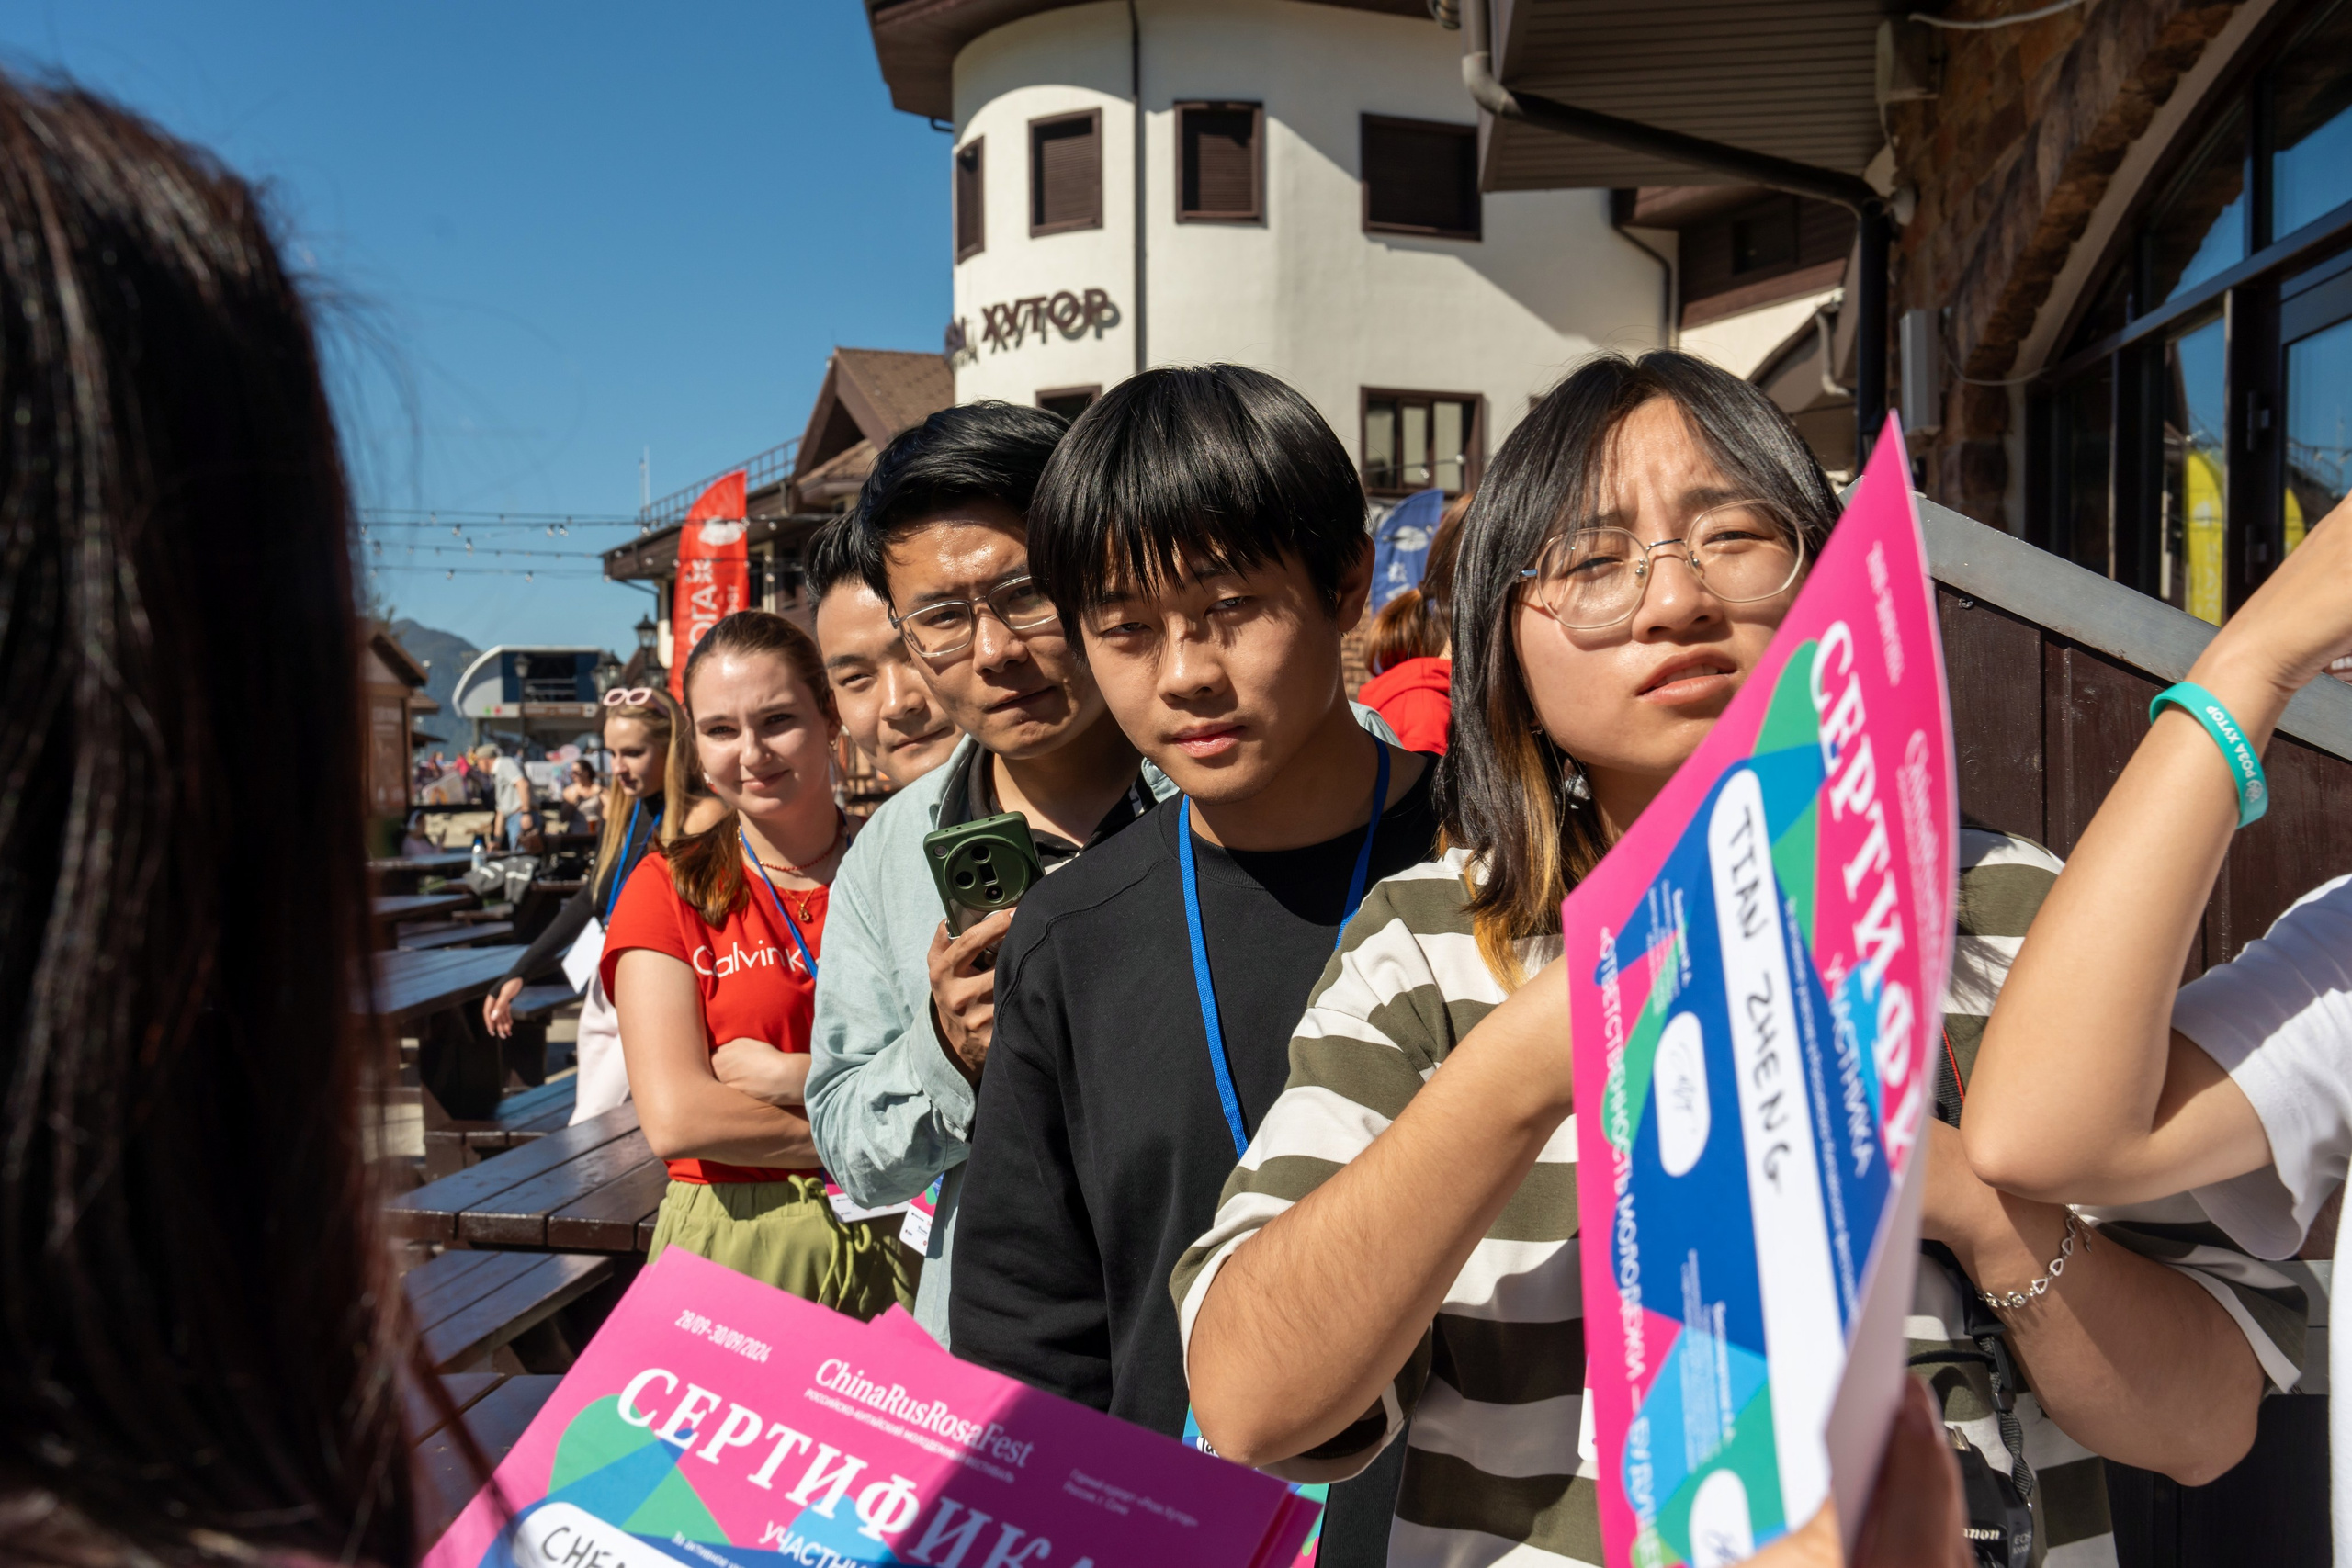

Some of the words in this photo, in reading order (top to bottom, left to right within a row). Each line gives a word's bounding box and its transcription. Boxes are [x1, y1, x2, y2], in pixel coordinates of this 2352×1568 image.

[980, 288, 1110, 344] ХУТОР
[2205, 705, 2242, 745] ХУТОР
[1725, 805, 1770, 941] TIAN
[693, 939, 786, 978] Calvin
[1743, 971, 1795, 1196] ZHENG
[1823, 951, 1882, 1179] УЧАСТНИКА
[673, 1308, 774, 1364] 28/09-30/09/2024
[1611, 1192, 1648, 1382] МОЛОДЕЖИ
[616, 1367, 1095, 1568] СЕРТИФИК
[814, 1358, 1035, 1468] ChinaRusRosaFest
[540, 1526, 627, 1568] CHE
